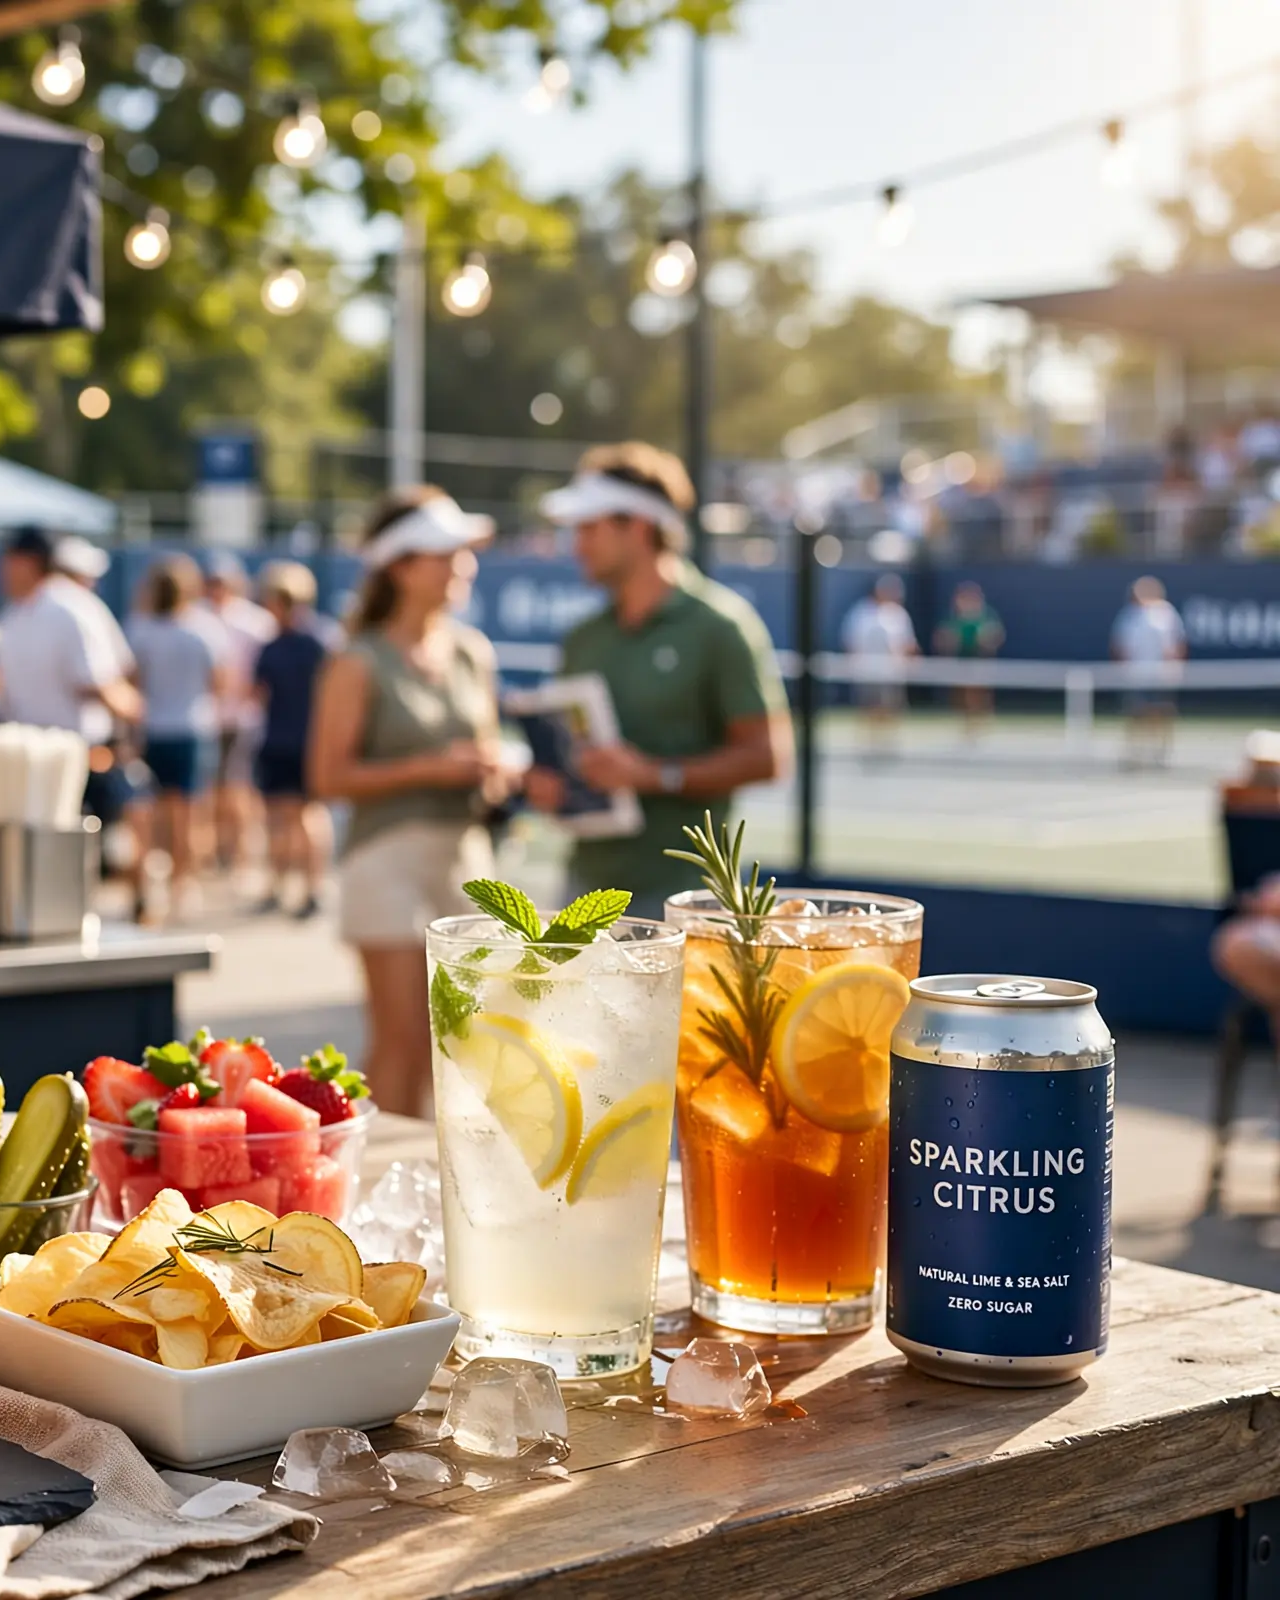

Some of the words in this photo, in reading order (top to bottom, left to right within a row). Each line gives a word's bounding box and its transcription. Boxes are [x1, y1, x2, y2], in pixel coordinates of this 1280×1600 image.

[909, 1139, 1084, 1176] SPARKLING
[933, 1181, 1055, 1214] CITRUS
[918, 1265, 969, 1285] NATURAL
[972, 1274, 1001, 1288] LIME
[1004, 1276, 1014, 1288] &
[1017, 1276, 1041, 1289] SEA
[1043, 1274, 1070, 1288] SALT
[948, 1297, 982, 1311] ZERO
[986, 1300, 1033, 1314] SUGAR
